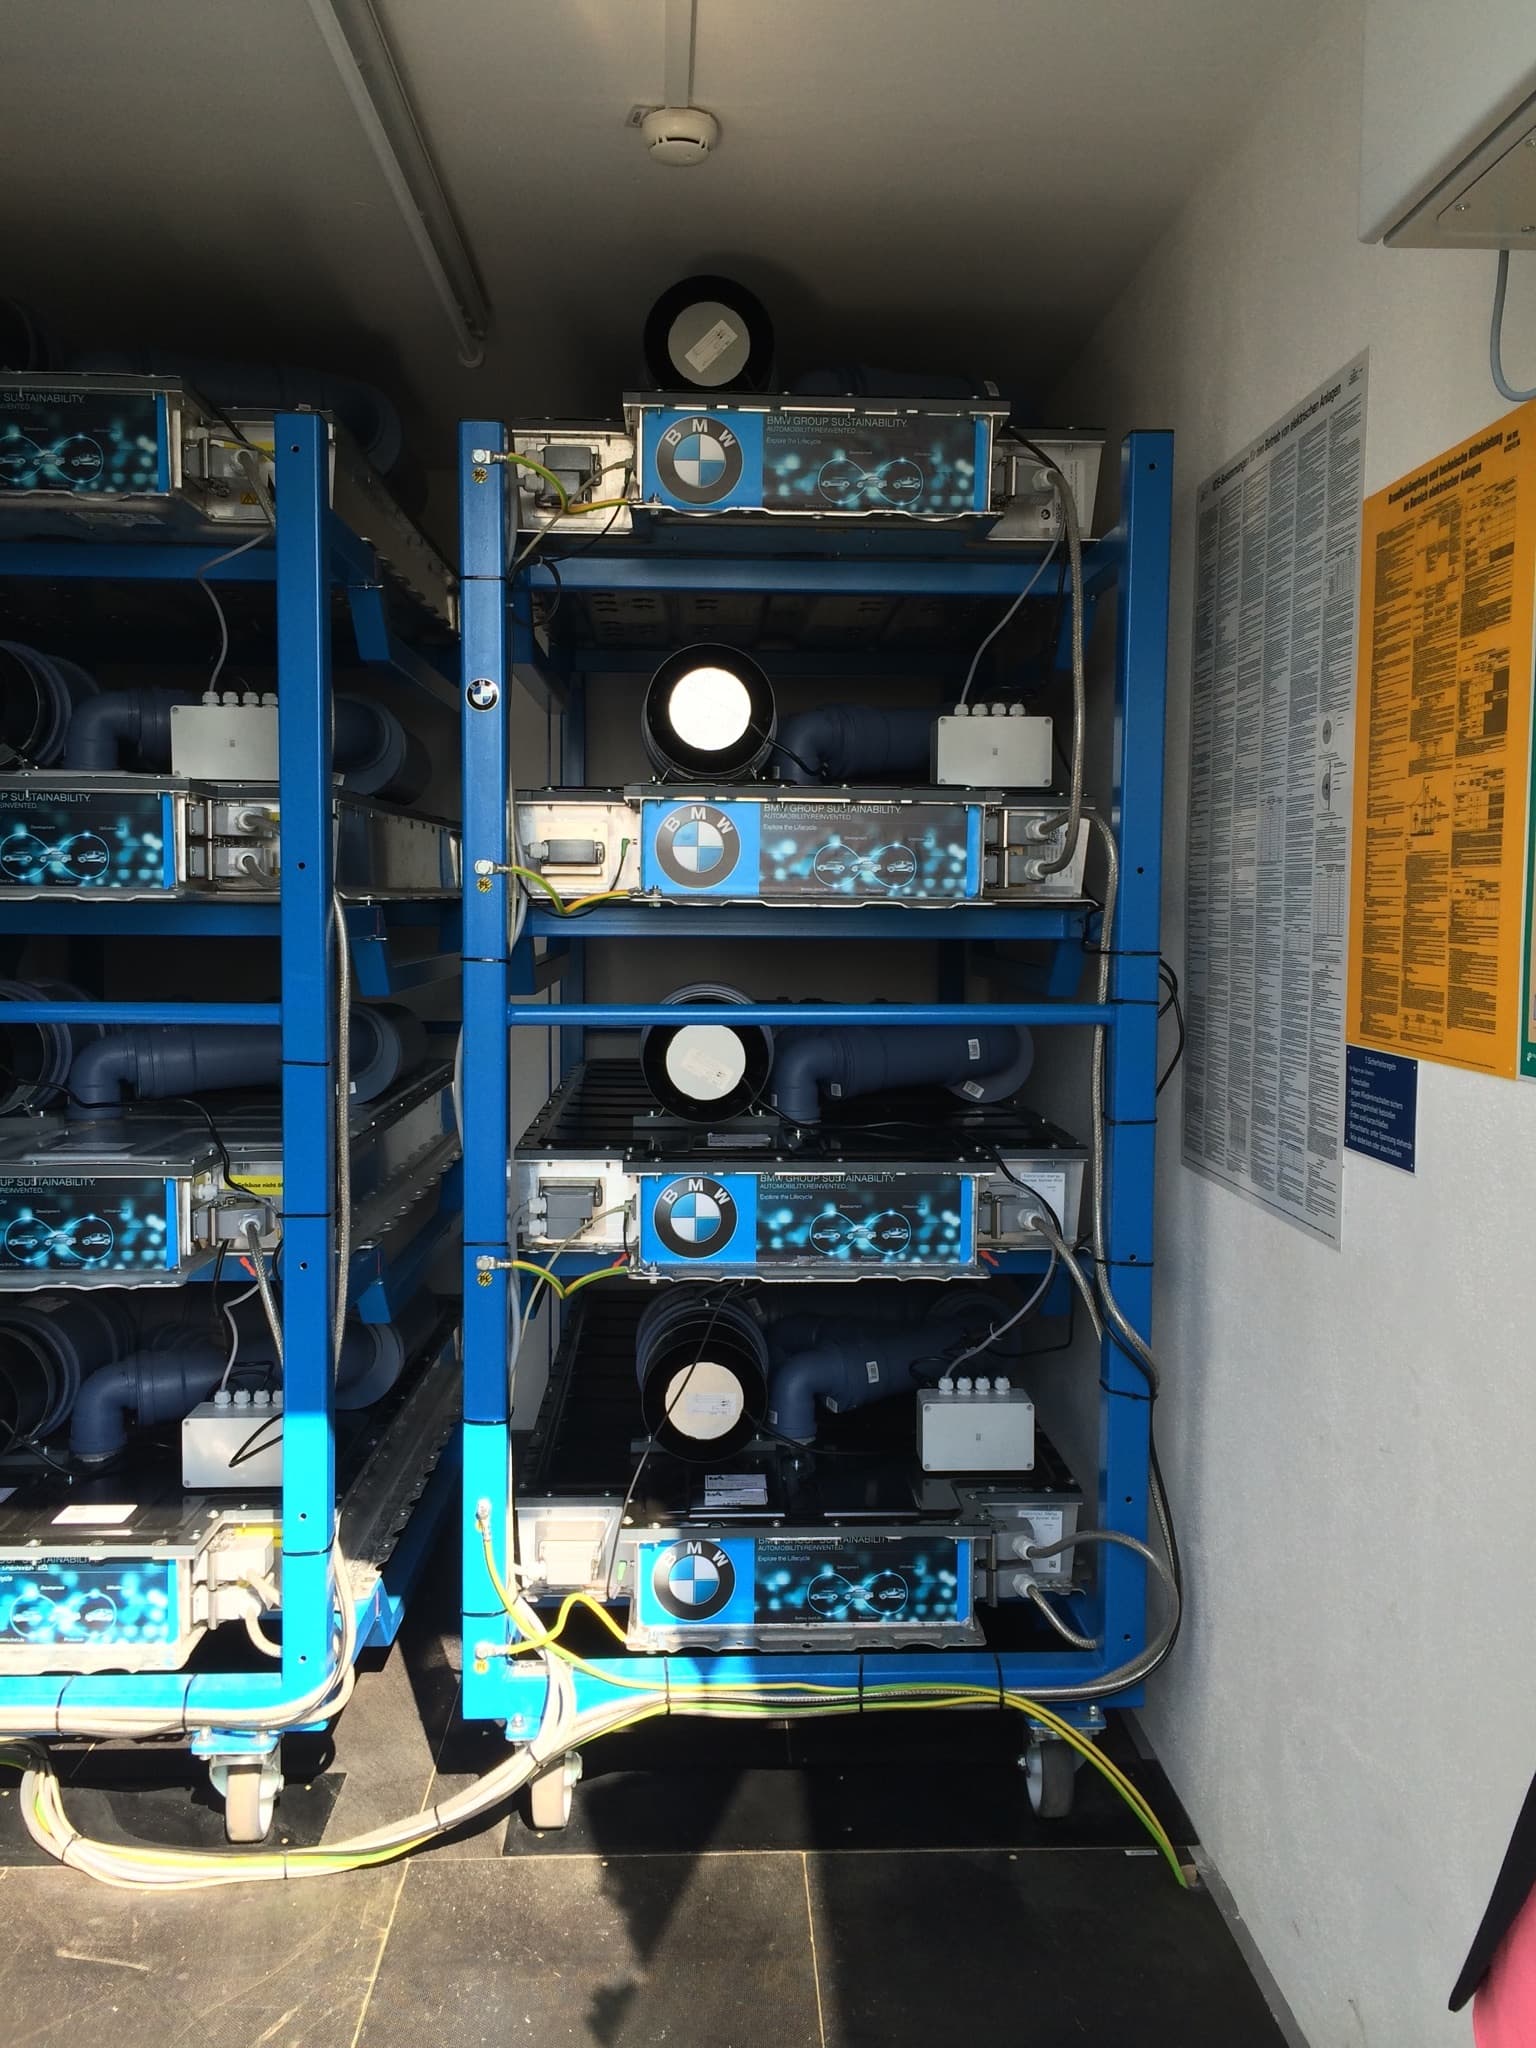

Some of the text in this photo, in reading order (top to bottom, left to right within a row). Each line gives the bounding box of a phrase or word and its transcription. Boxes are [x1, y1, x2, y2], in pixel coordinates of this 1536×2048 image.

[664, 418, 736, 448] BMW
[767, 416, 790, 425] BMW
[794, 417, 829, 426] GROUP
[664, 806, 734, 834] BMW
[790, 804, 824, 812] GROUP
[662, 1179, 730, 1204] BMW
[663, 1542, 728, 1568] BMW
